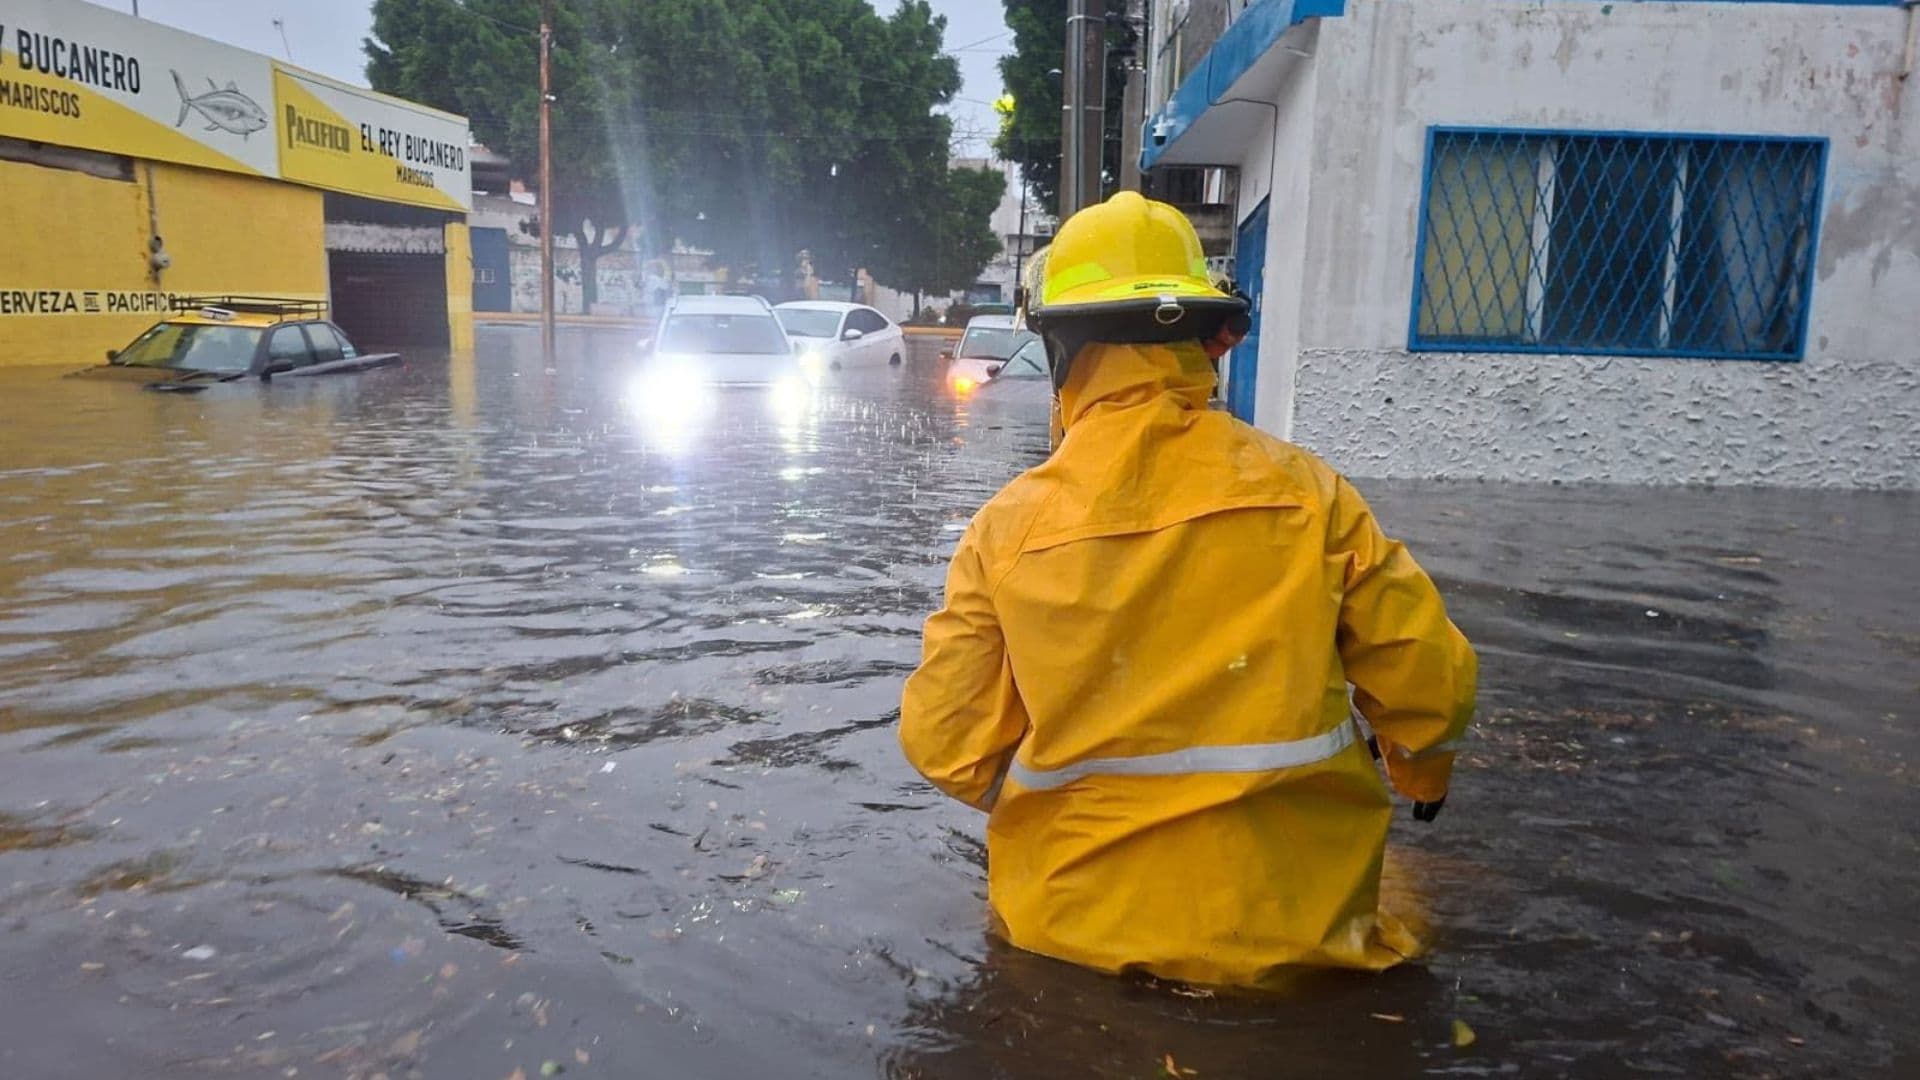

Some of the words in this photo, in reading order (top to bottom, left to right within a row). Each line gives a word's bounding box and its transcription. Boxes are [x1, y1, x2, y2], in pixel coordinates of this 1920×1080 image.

[17, 29, 140, 94] BUCANERO
[0, 78, 80, 118] MARISCOS
[361, 123, 374, 152] EL
[379, 128, 401, 159] REY
[406, 135, 464, 172] BUCANERO
[397, 166, 434, 188] MARISCOS
[0, 291, 78, 314] ERVEZA
